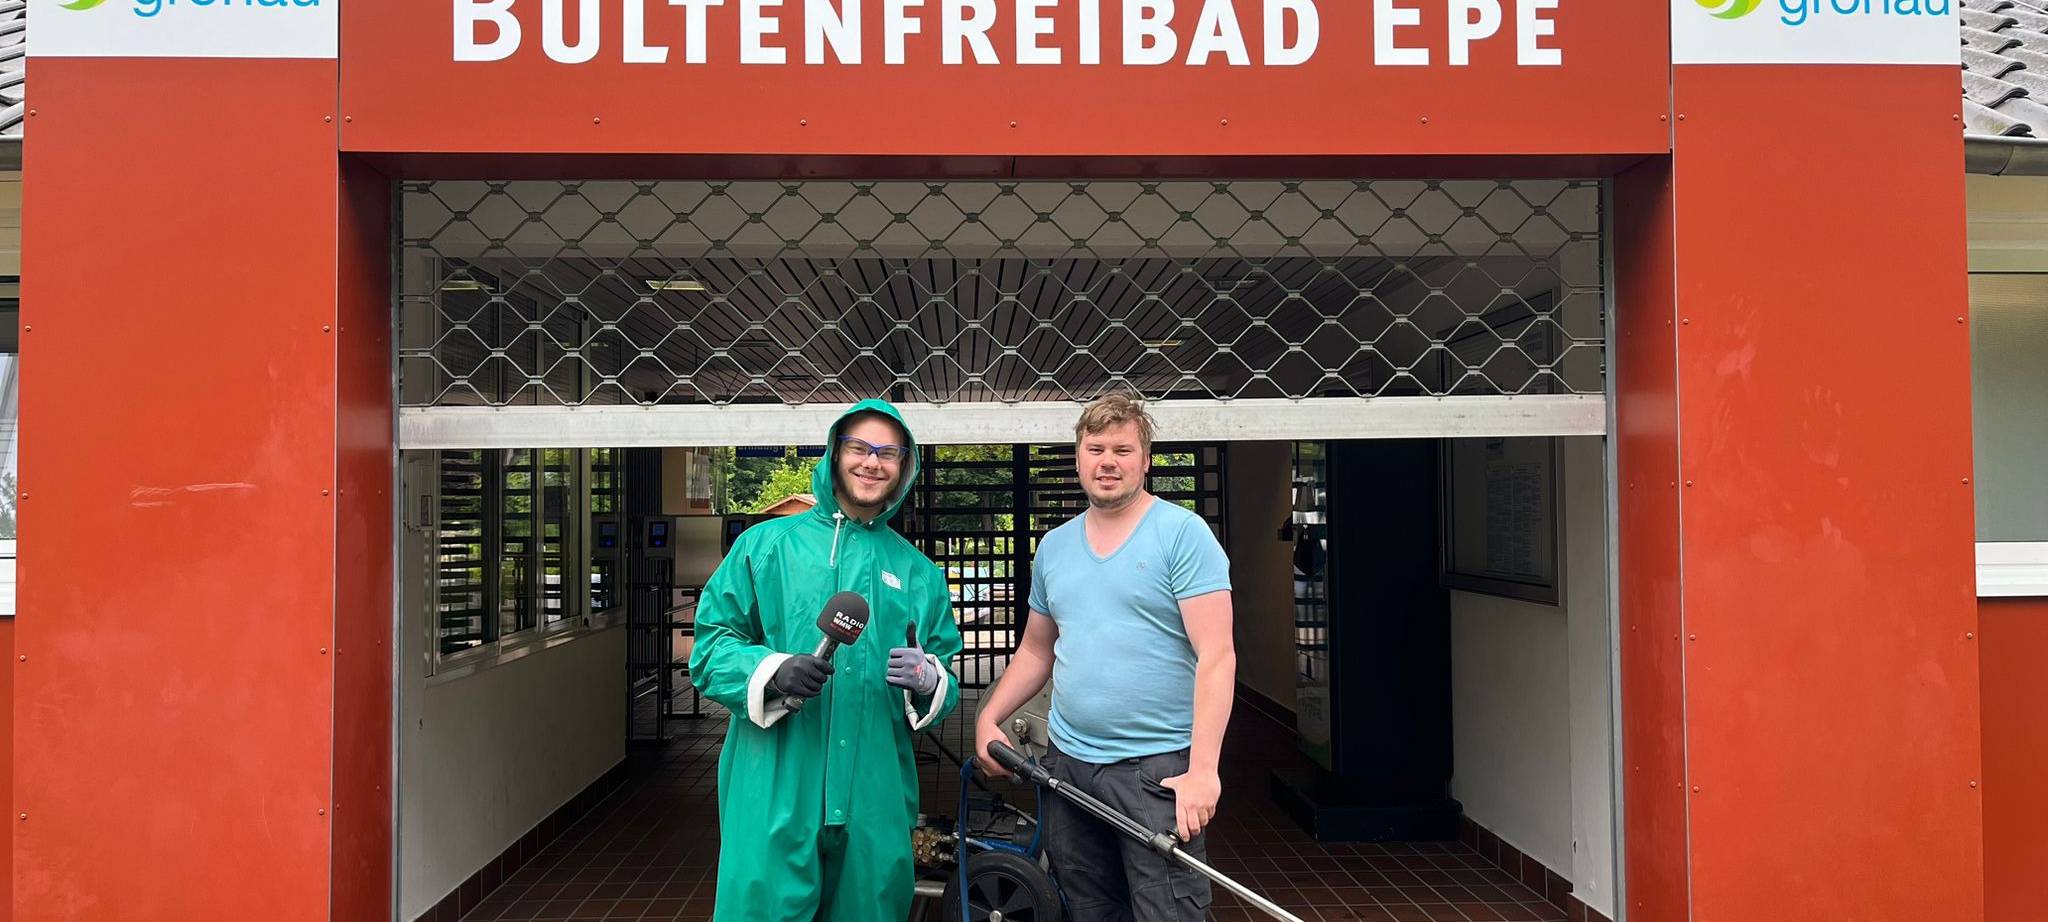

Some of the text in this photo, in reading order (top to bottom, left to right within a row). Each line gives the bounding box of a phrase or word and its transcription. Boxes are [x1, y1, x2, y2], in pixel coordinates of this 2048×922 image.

[1373, 0, 1562, 65] EPE
[833, 617, 853, 630] WMW
[836, 611, 864, 629] RADIO
